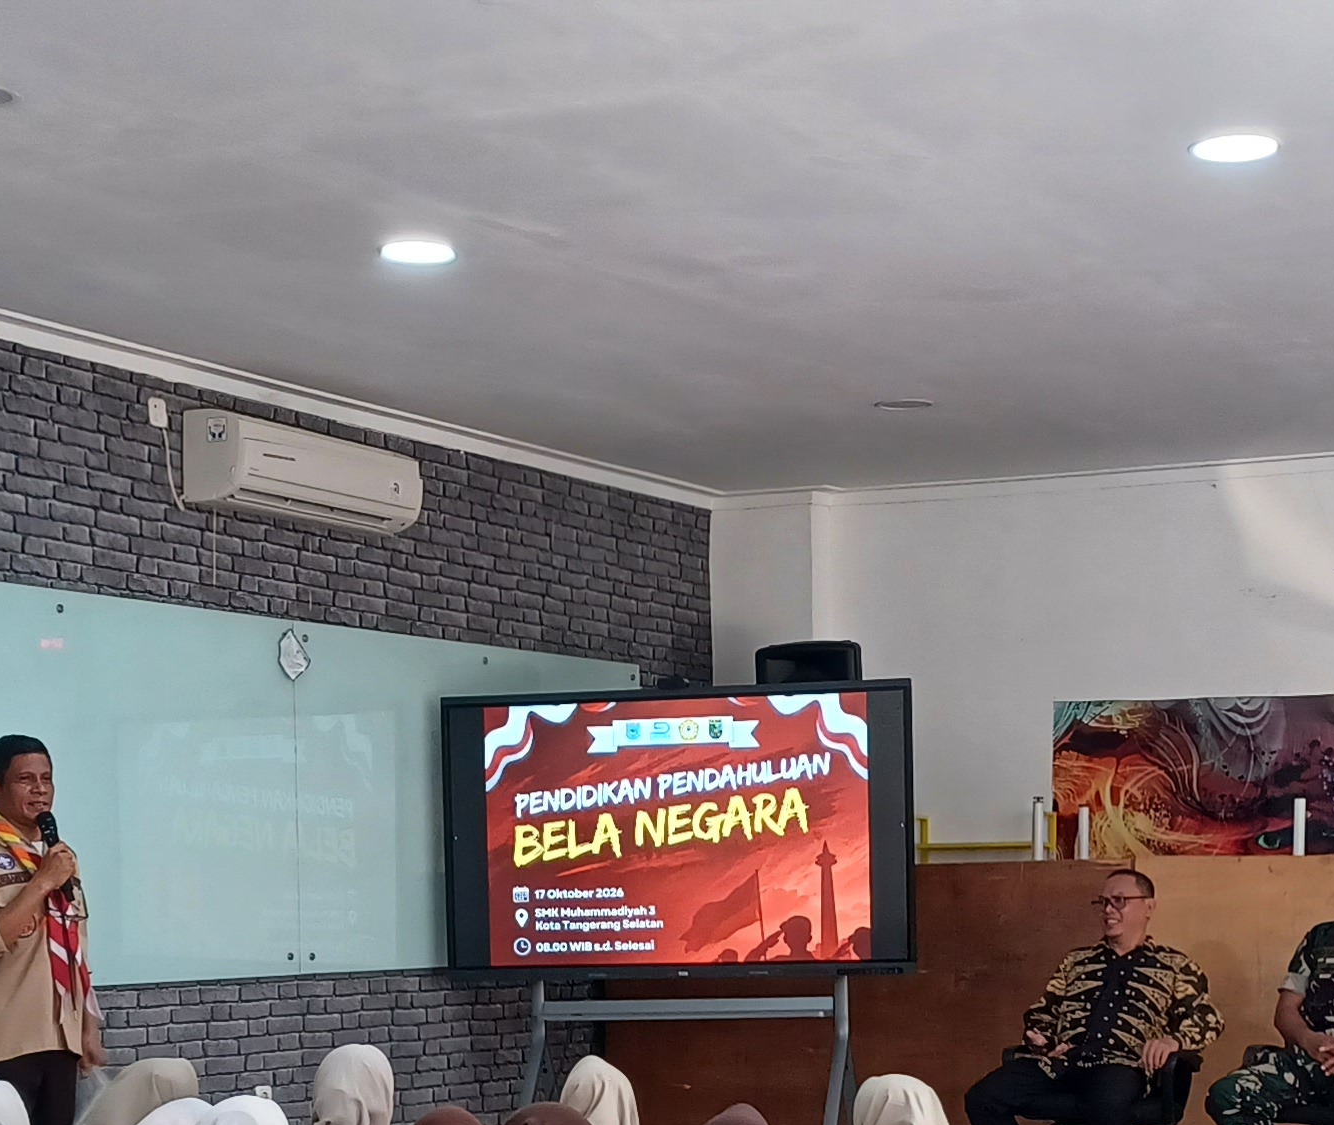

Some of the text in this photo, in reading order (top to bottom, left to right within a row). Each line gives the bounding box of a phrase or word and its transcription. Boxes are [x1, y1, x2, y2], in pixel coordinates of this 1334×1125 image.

[515, 752, 831, 818] PENDIDIKAN PENDAHULUAN
[514, 788, 809, 867] BELA NEGARA
[534, 889, 545, 899] 17
[547, 888, 594, 899] Oktober
[534, 907, 559, 918] SMK
[560, 905, 647, 917] Muhammadiyah
[535, 918, 664, 931] Kota Tangerang Selatan
[536, 942, 568, 953] 08.00
[569, 941, 593, 952] WIB
[615, 939, 655, 951] Selesai
